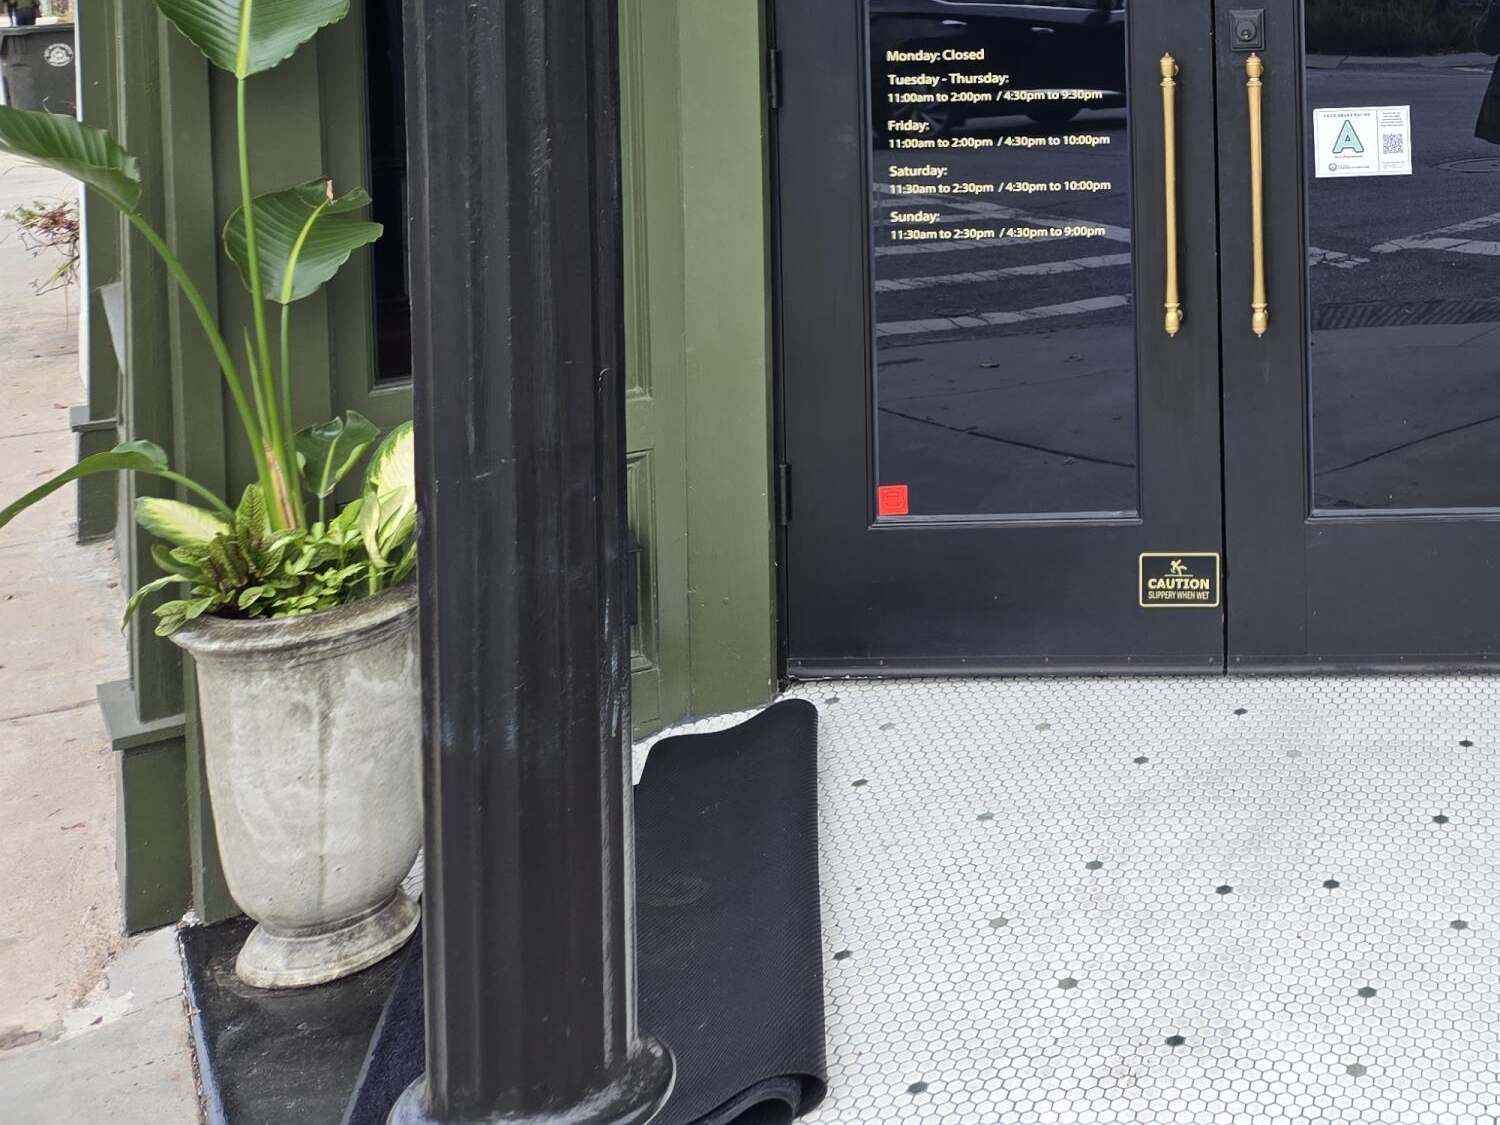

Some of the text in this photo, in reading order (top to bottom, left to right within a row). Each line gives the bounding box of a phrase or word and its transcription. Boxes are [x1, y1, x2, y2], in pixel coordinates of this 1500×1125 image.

[886, 49, 984, 63] Monday: Closed
[888, 74, 939, 87] Tuesday
[949, 73, 1009, 86] Thursday:
[888, 93, 934, 103] 11:00am
[936, 93, 948, 102] to
[950, 92, 992, 104] 2:00pm
[1003, 91, 1045, 102] 4:30pm
[1046, 91, 1059, 100] to
[1061, 90, 1102, 101] 9:30pm
[888, 120, 929, 133] Friday:
[889, 139, 935, 148] 11:00am
[937, 138, 949, 147] to
[951, 137, 993, 149] 2:00pm
[1004, 136, 1046, 148] 4:30pm
[1048, 136, 1060, 146] to
[1062, 135, 1110, 147] 10:00pm
[1332, 119, 1364, 154] A
[889, 165, 947, 178] Saturday:
[889, 184, 936, 194] 11:30am
[938, 184, 950, 193] to
[952, 183, 994, 195] 2:30pm
[1005, 182, 1047, 193] 4:30pm
[1049, 182, 1061, 191] to
[1063, 181, 1111, 192] 10:00pm
[890, 211, 940, 224] Sunday:
[891, 230, 937, 240] 11:30am
[938, 230, 951, 239] to
[953, 229, 995, 240] 2:30pm
[1006, 228, 1048, 239] 4:30pm
[1049, 228, 1062, 237] to
[1063, 227, 1105, 238] 9:00pm
[1148, 578, 1209, 590] CAUTION
[1148, 591, 1209, 600] SLIPPERY WHEN WET
